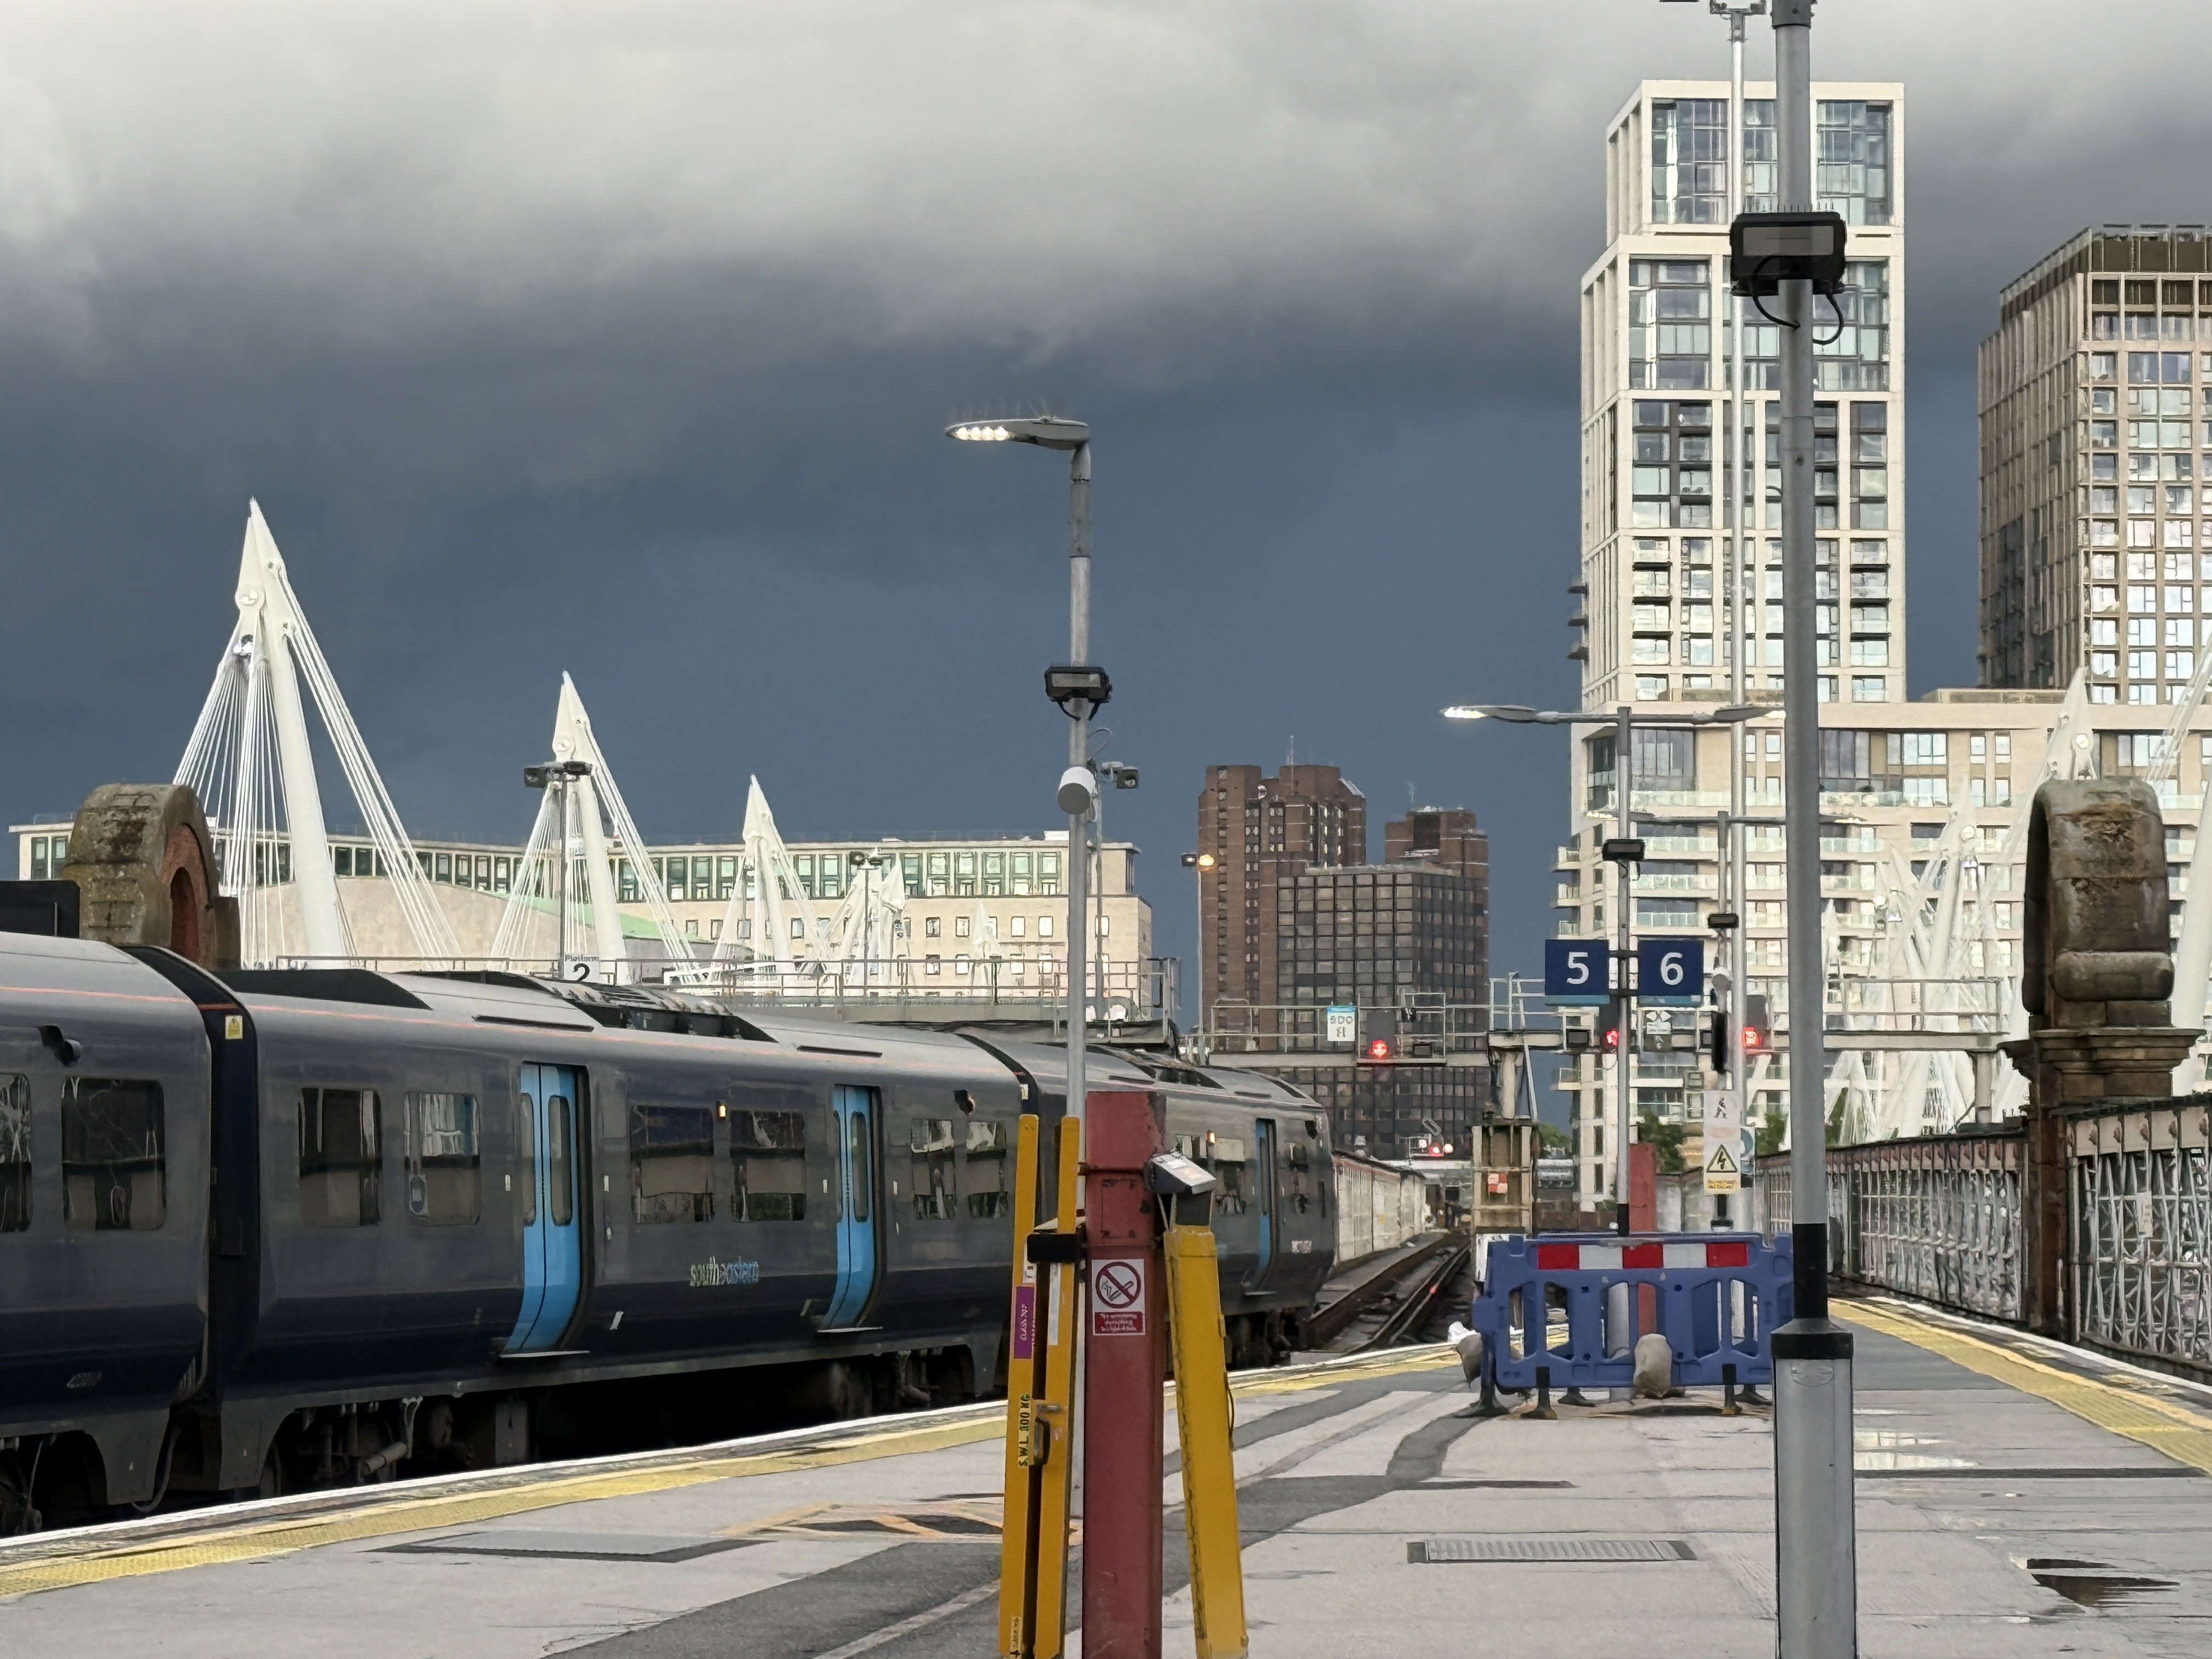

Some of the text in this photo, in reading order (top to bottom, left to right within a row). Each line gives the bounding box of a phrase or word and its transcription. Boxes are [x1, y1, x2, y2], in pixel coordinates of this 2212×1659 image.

[572, 963, 590, 981] 2
[1566, 951, 1590, 985] 5
[1660, 952, 1684, 985] 6
